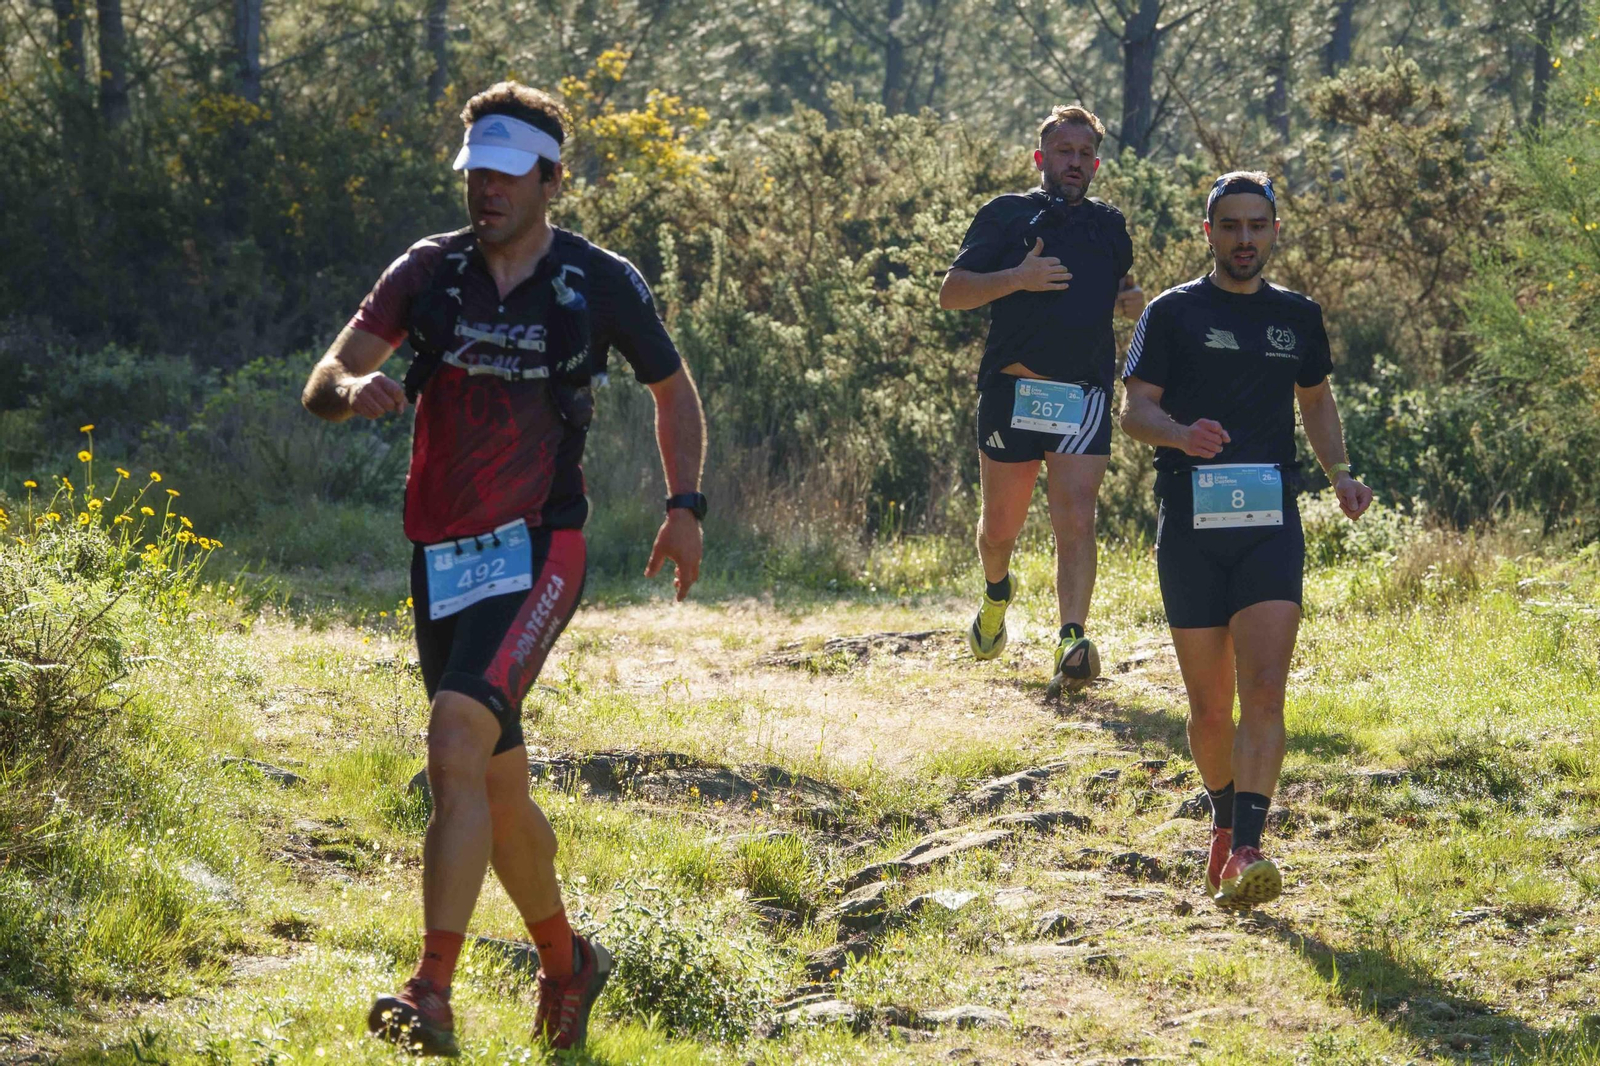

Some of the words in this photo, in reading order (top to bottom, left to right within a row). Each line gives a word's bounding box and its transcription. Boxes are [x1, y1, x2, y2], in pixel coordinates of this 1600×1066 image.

[624, 263, 649, 305] TRAIL
[1275, 329, 1291, 343] 25
[1031, 400, 1065, 419] 267
[1231, 489, 1245, 509] 8
[457, 557, 506, 588] 492
[510, 574, 566, 667] PONTESECA
